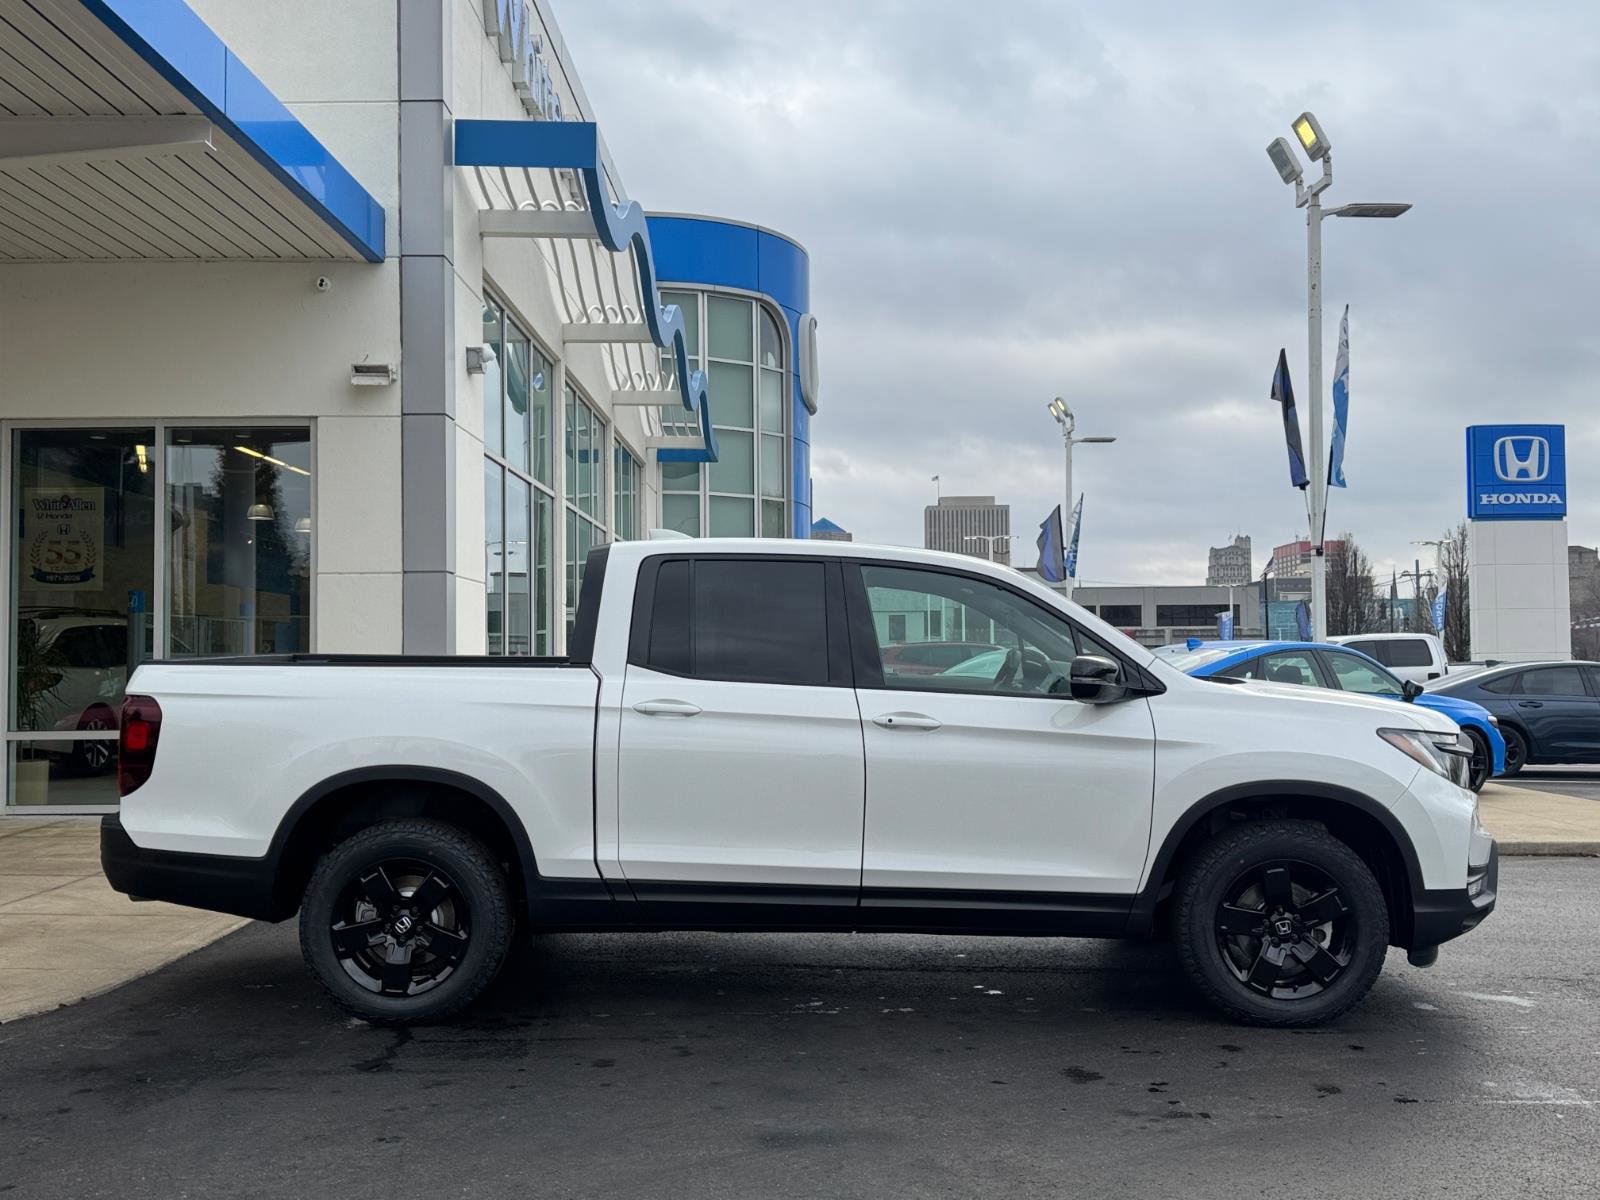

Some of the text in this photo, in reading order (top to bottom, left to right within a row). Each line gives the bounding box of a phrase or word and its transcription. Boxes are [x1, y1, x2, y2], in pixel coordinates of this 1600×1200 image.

[67, 499, 96, 511] Allen
[1480, 493, 1563, 505] HONDA
[45, 540, 81, 564] 55
